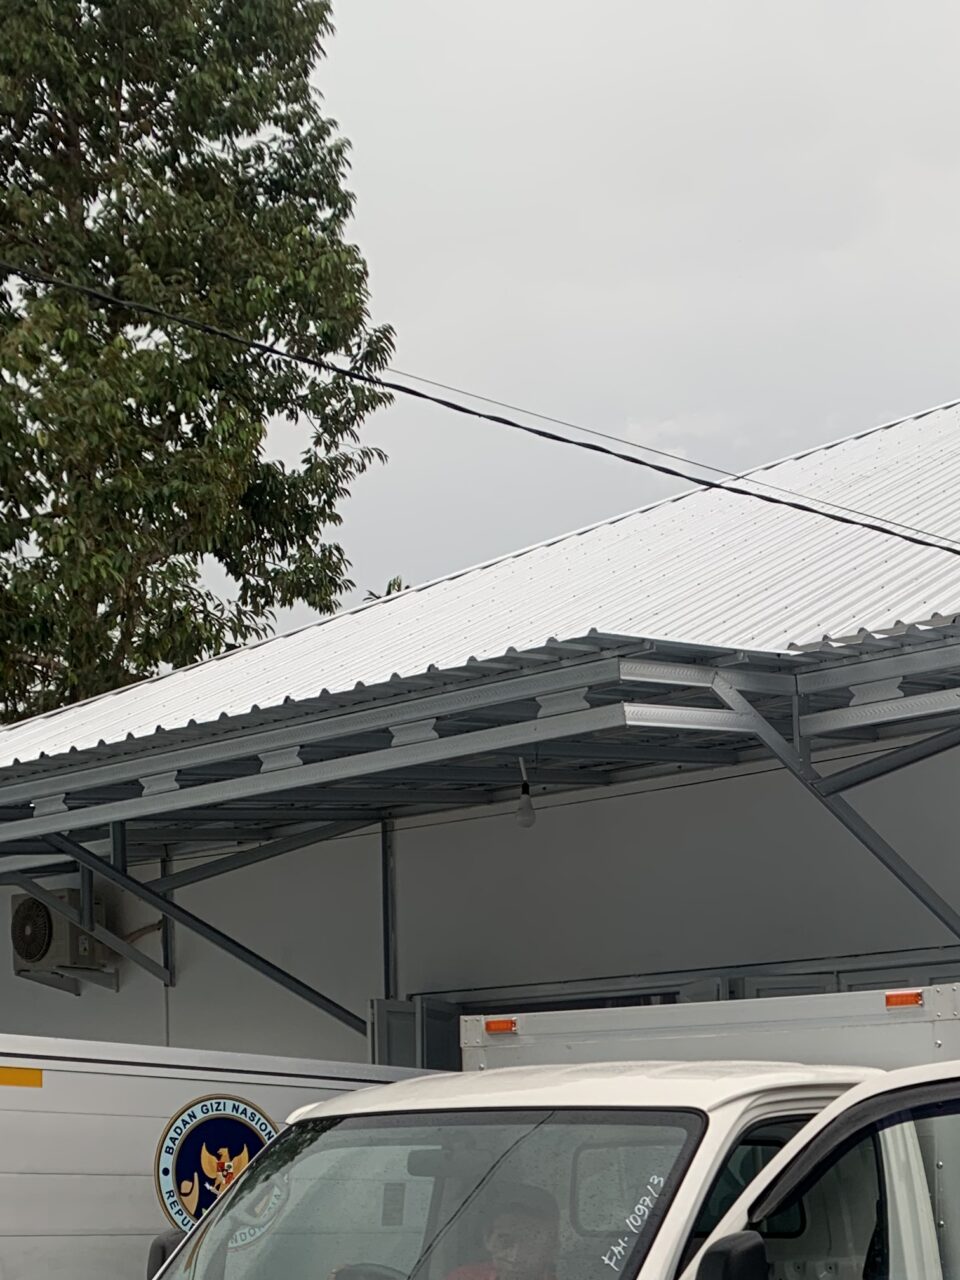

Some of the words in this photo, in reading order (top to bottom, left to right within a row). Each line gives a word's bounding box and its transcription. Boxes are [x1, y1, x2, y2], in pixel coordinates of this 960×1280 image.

[164, 1110, 198, 1156] BADAN
[200, 1101, 227, 1115] GIZI
[165, 1190, 196, 1232] REPU
